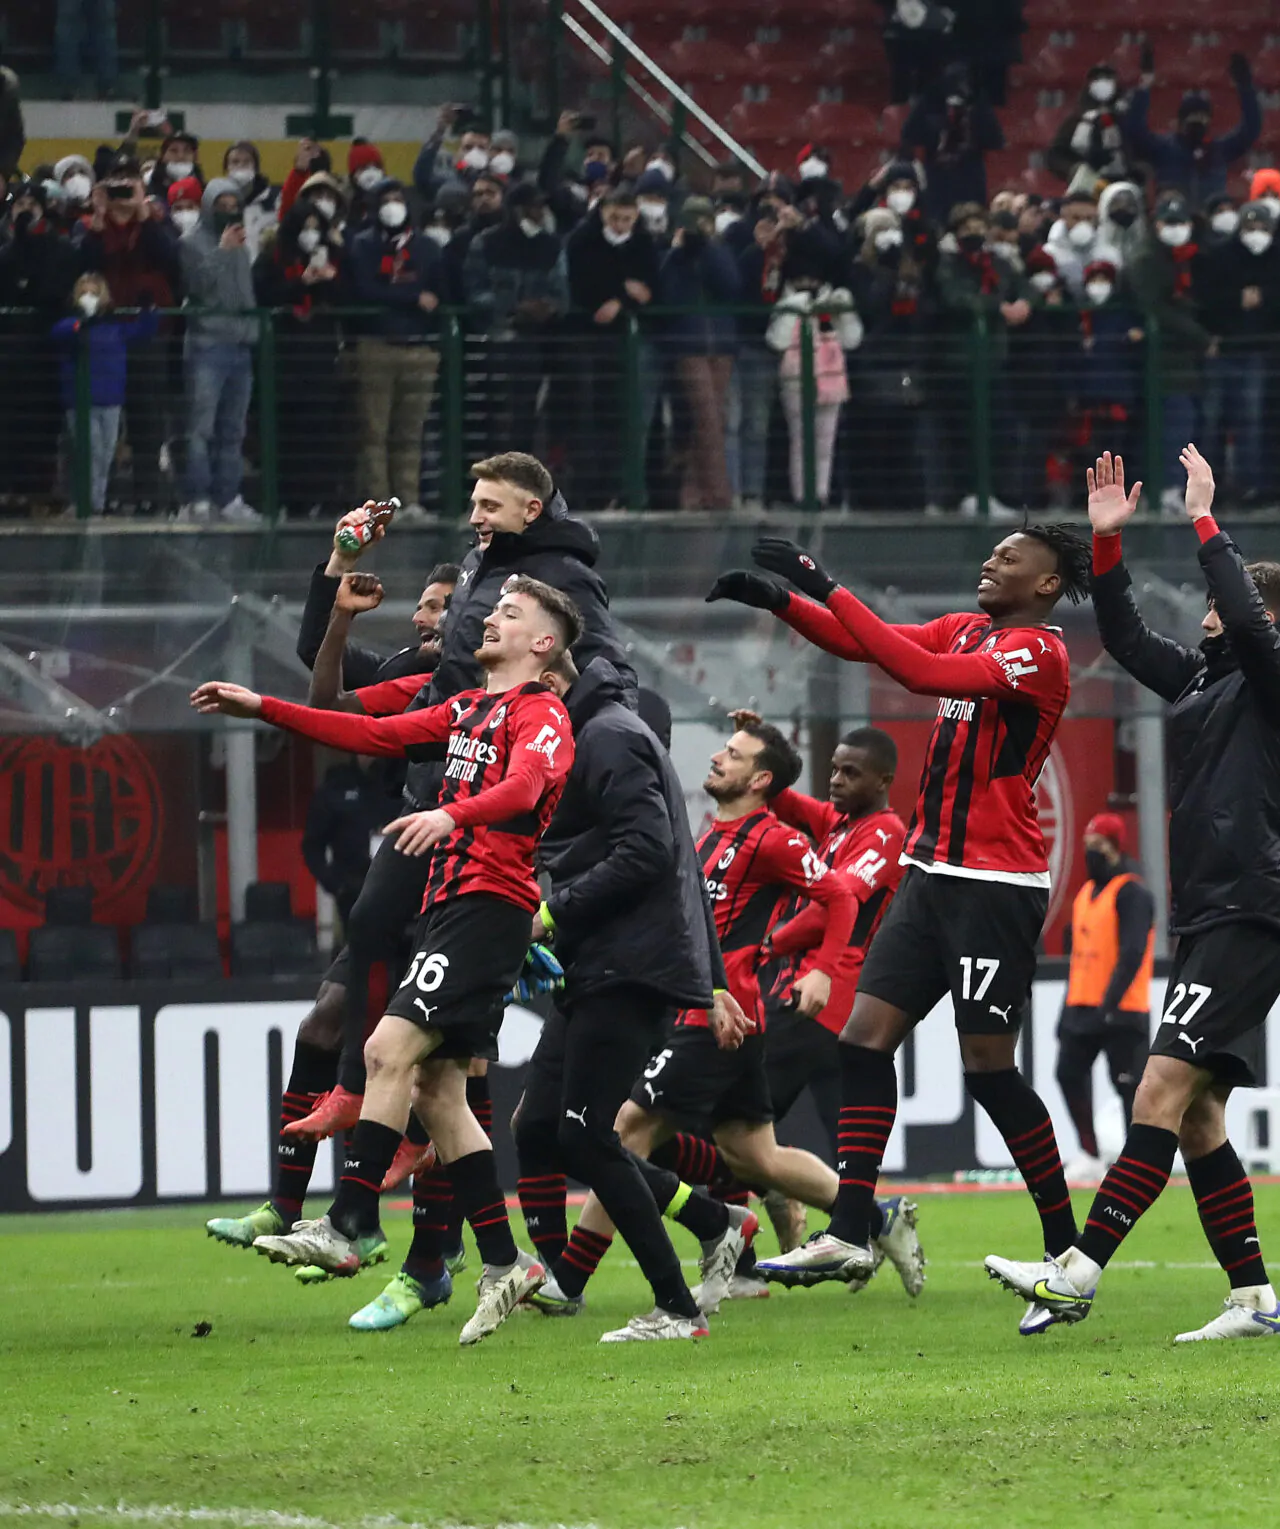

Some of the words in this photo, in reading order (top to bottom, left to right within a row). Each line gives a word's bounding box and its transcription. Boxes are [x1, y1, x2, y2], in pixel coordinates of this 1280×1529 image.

[991, 650, 1020, 690] BitMEX
[448, 731, 498, 765] mirates
[399, 951, 450, 992] 56
[959, 956, 1000, 1001] 17
[1162, 982, 1212, 1026] 27
[1103, 1205, 1132, 1227] ACM
